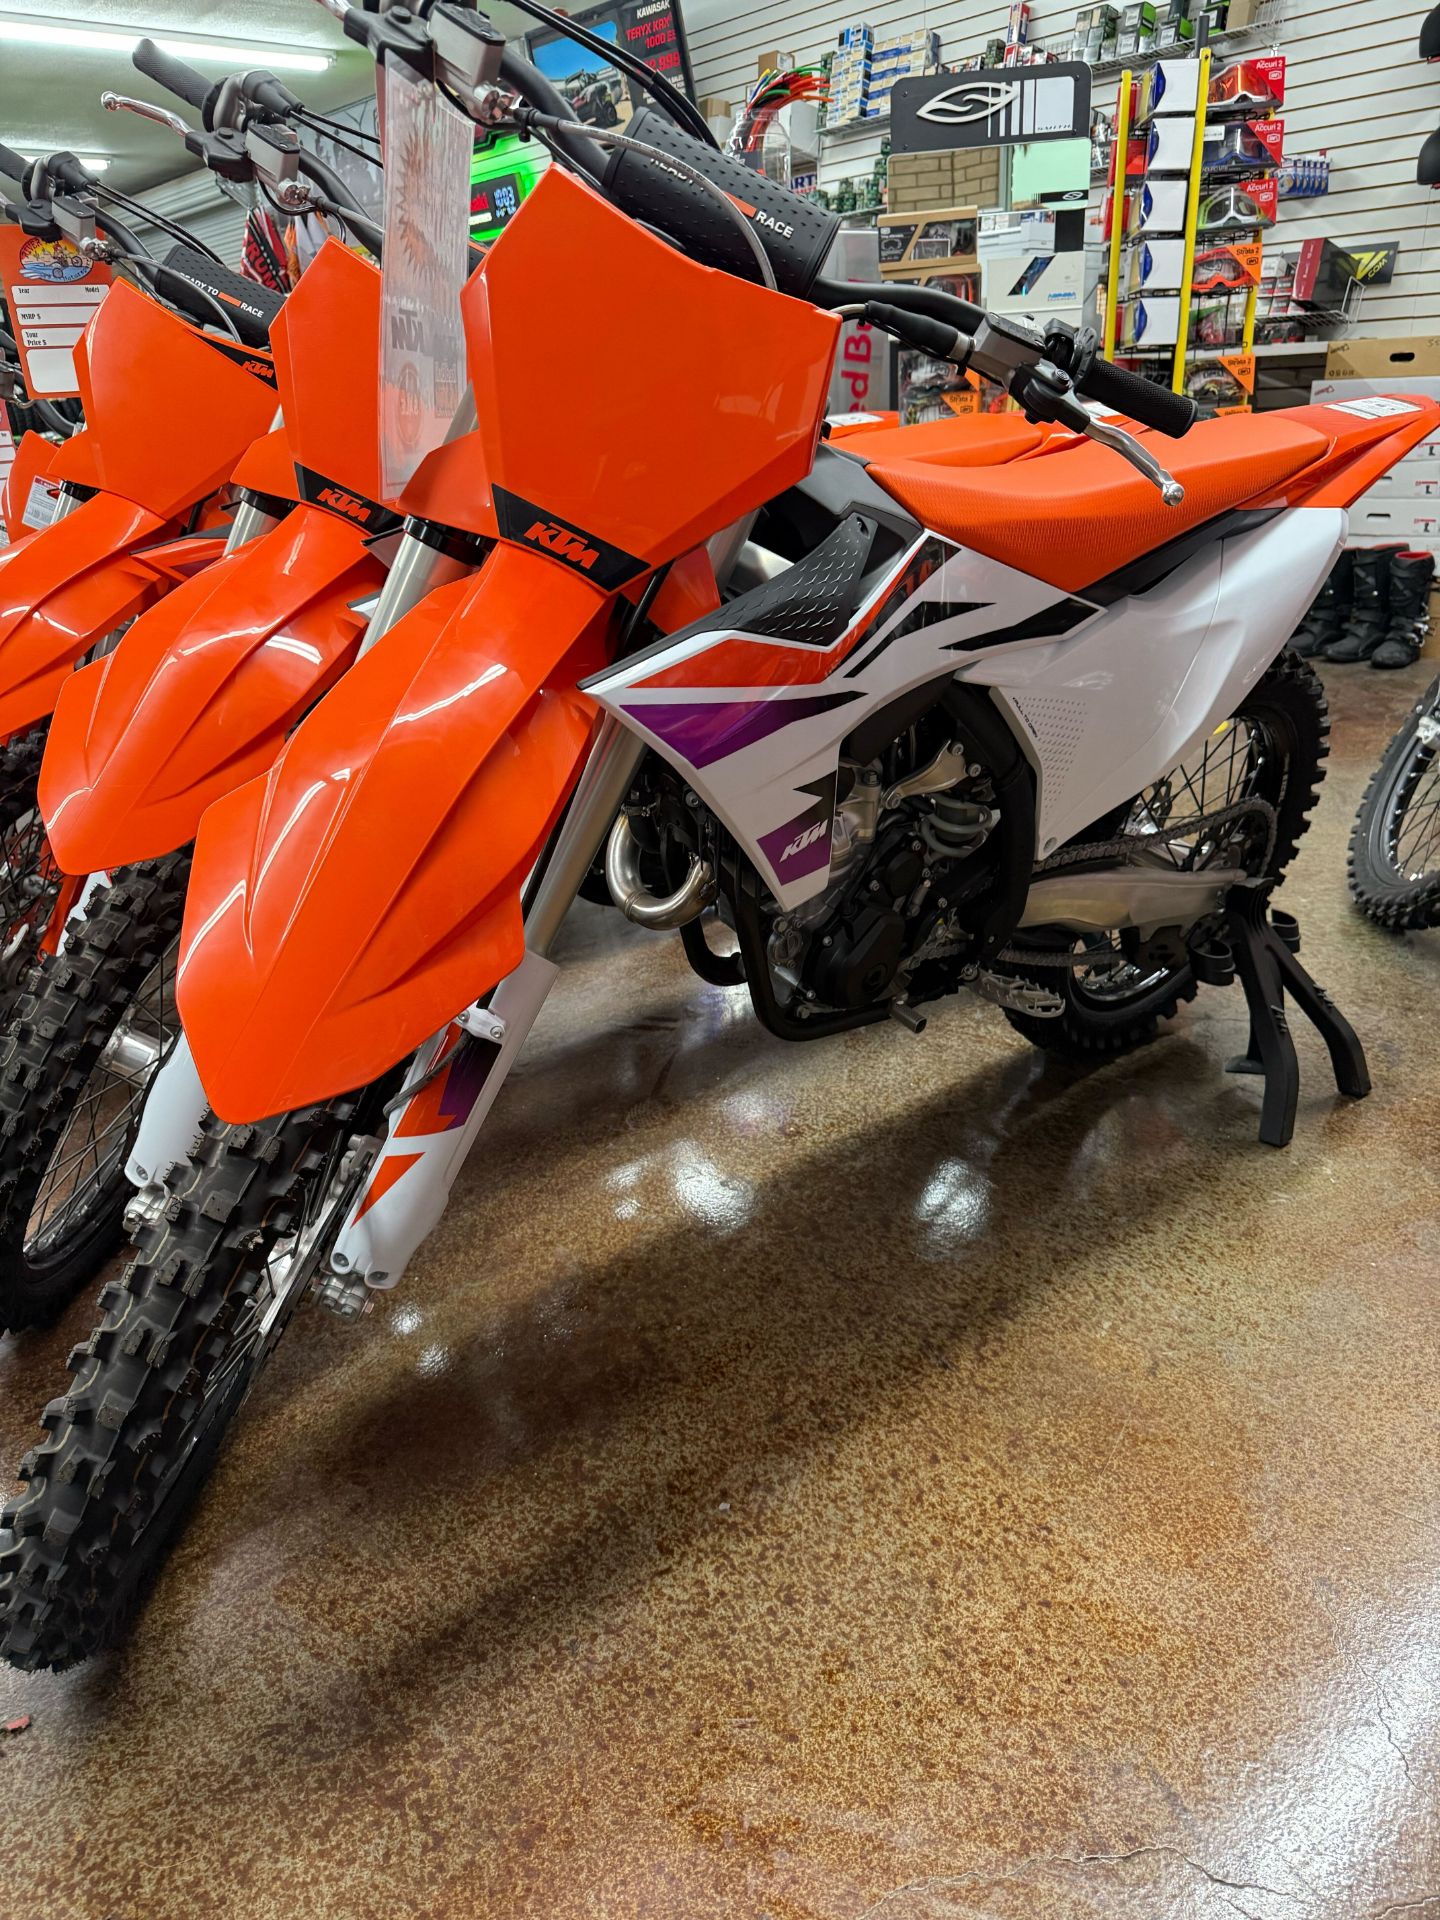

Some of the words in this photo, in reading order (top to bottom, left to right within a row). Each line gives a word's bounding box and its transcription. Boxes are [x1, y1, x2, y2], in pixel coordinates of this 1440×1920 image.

[636, 0, 671, 19] KAWASAK
[626, 23, 652, 41] TERYX
[645, 34, 666, 48] 1000
[1256, 61, 1278, 69] Accuri
[1254, 124, 1277, 132] Accuri
[1246, 183, 1269, 192] Accuri
[755, 211, 795, 240] RACE
[207, 285, 219, 296] TO
[240, 302, 264, 318] RACE
[242, 360, 275, 379] KTM
[316, 487, 371, 522] KTM
[523, 521, 600, 570] KTM
[779, 818, 829, 863] KTM
